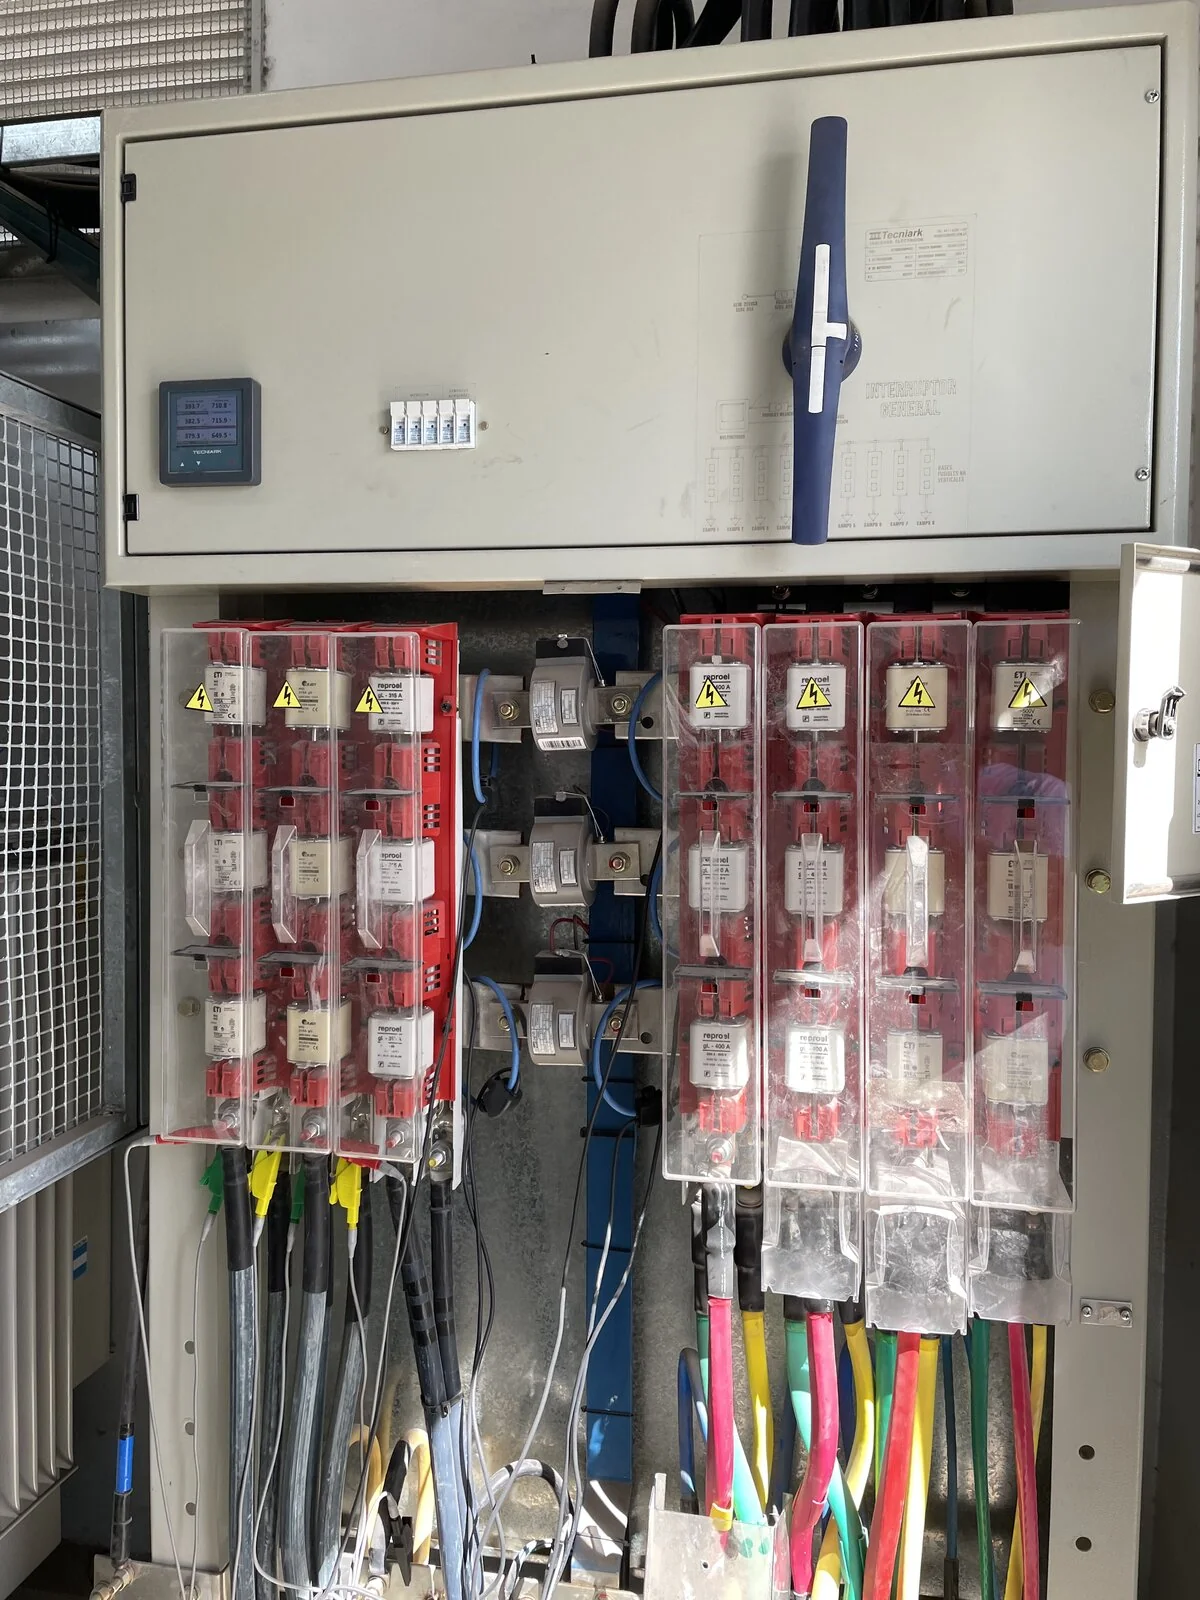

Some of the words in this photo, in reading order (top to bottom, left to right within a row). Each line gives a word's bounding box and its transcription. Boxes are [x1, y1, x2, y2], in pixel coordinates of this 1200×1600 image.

[882, 228, 923, 240] Tecniark
[865, 378, 957, 400] INTERRUPTOR
[880, 400, 941, 418] GENERAL
[801, 675, 830, 683] reroel
[1014, 671, 1027, 679] ETI
